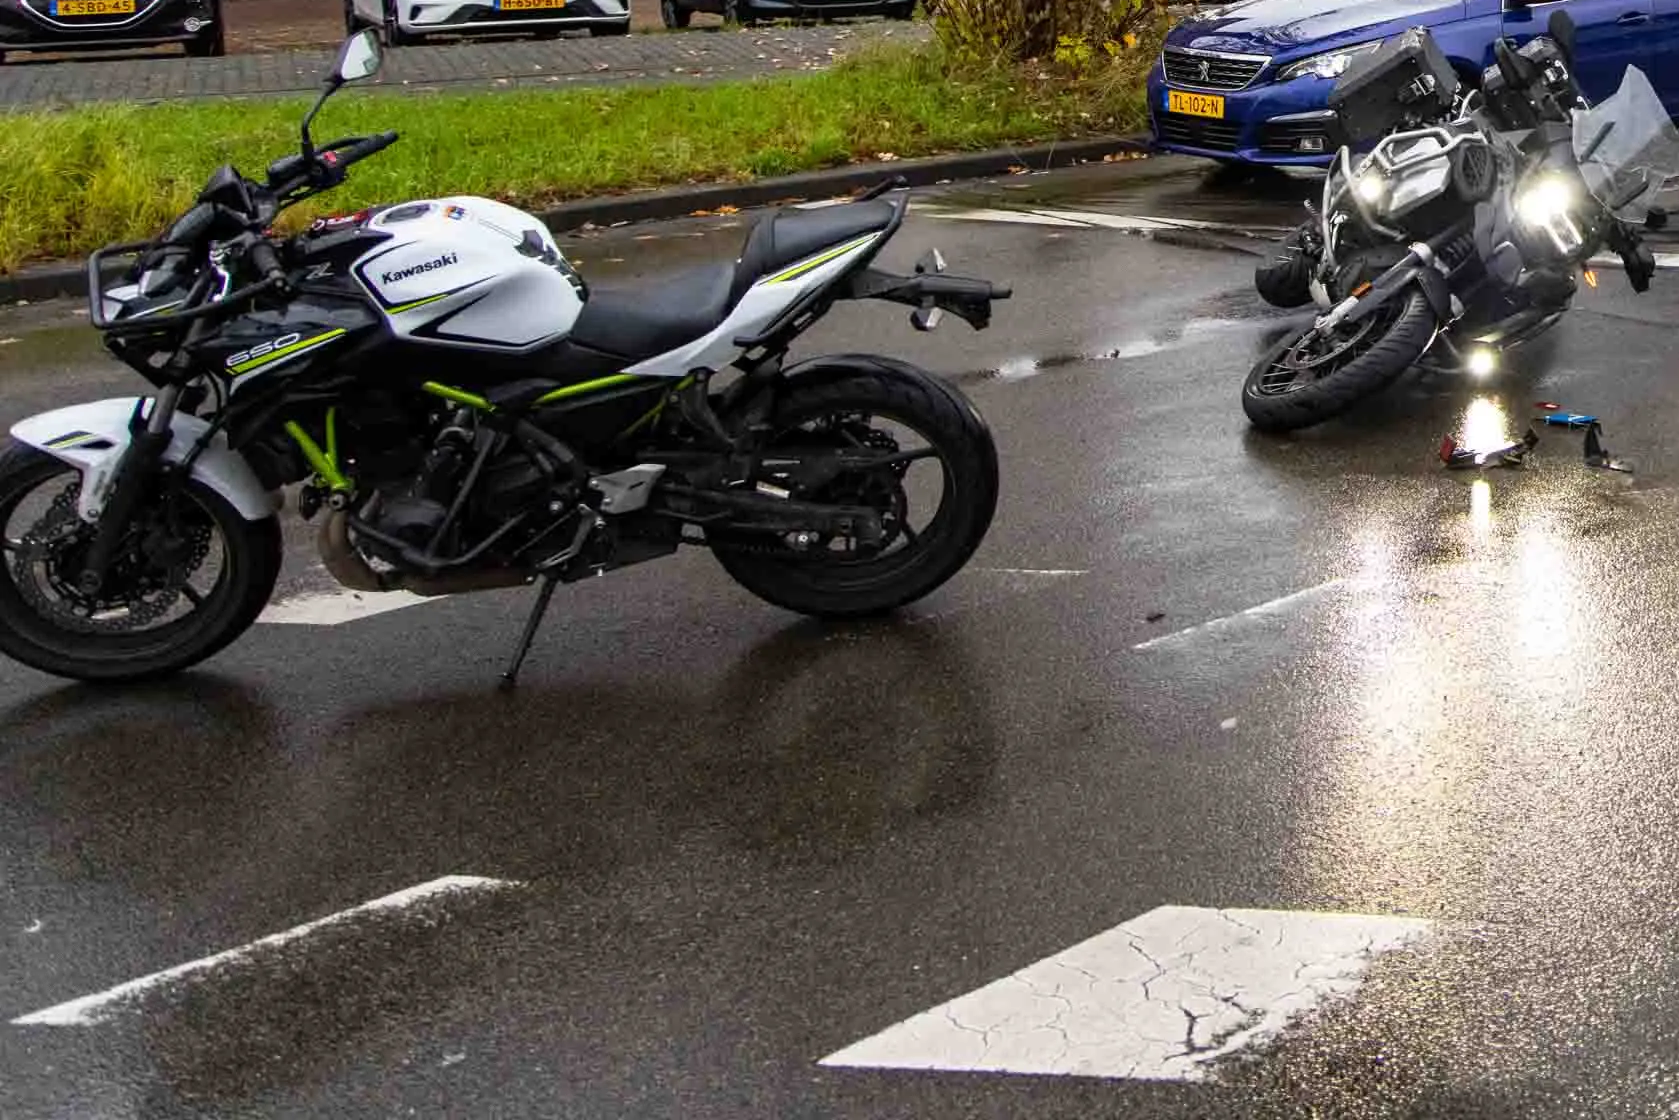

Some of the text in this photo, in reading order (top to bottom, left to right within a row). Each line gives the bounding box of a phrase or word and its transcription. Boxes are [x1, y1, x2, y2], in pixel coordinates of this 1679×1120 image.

[61, 0, 131, 14] 4-SBD-45
[1171, 94, 1219, 115] TL-102-N
[381, 252, 459, 285] Kawasaki
[225, 331, 301, 367] 650
